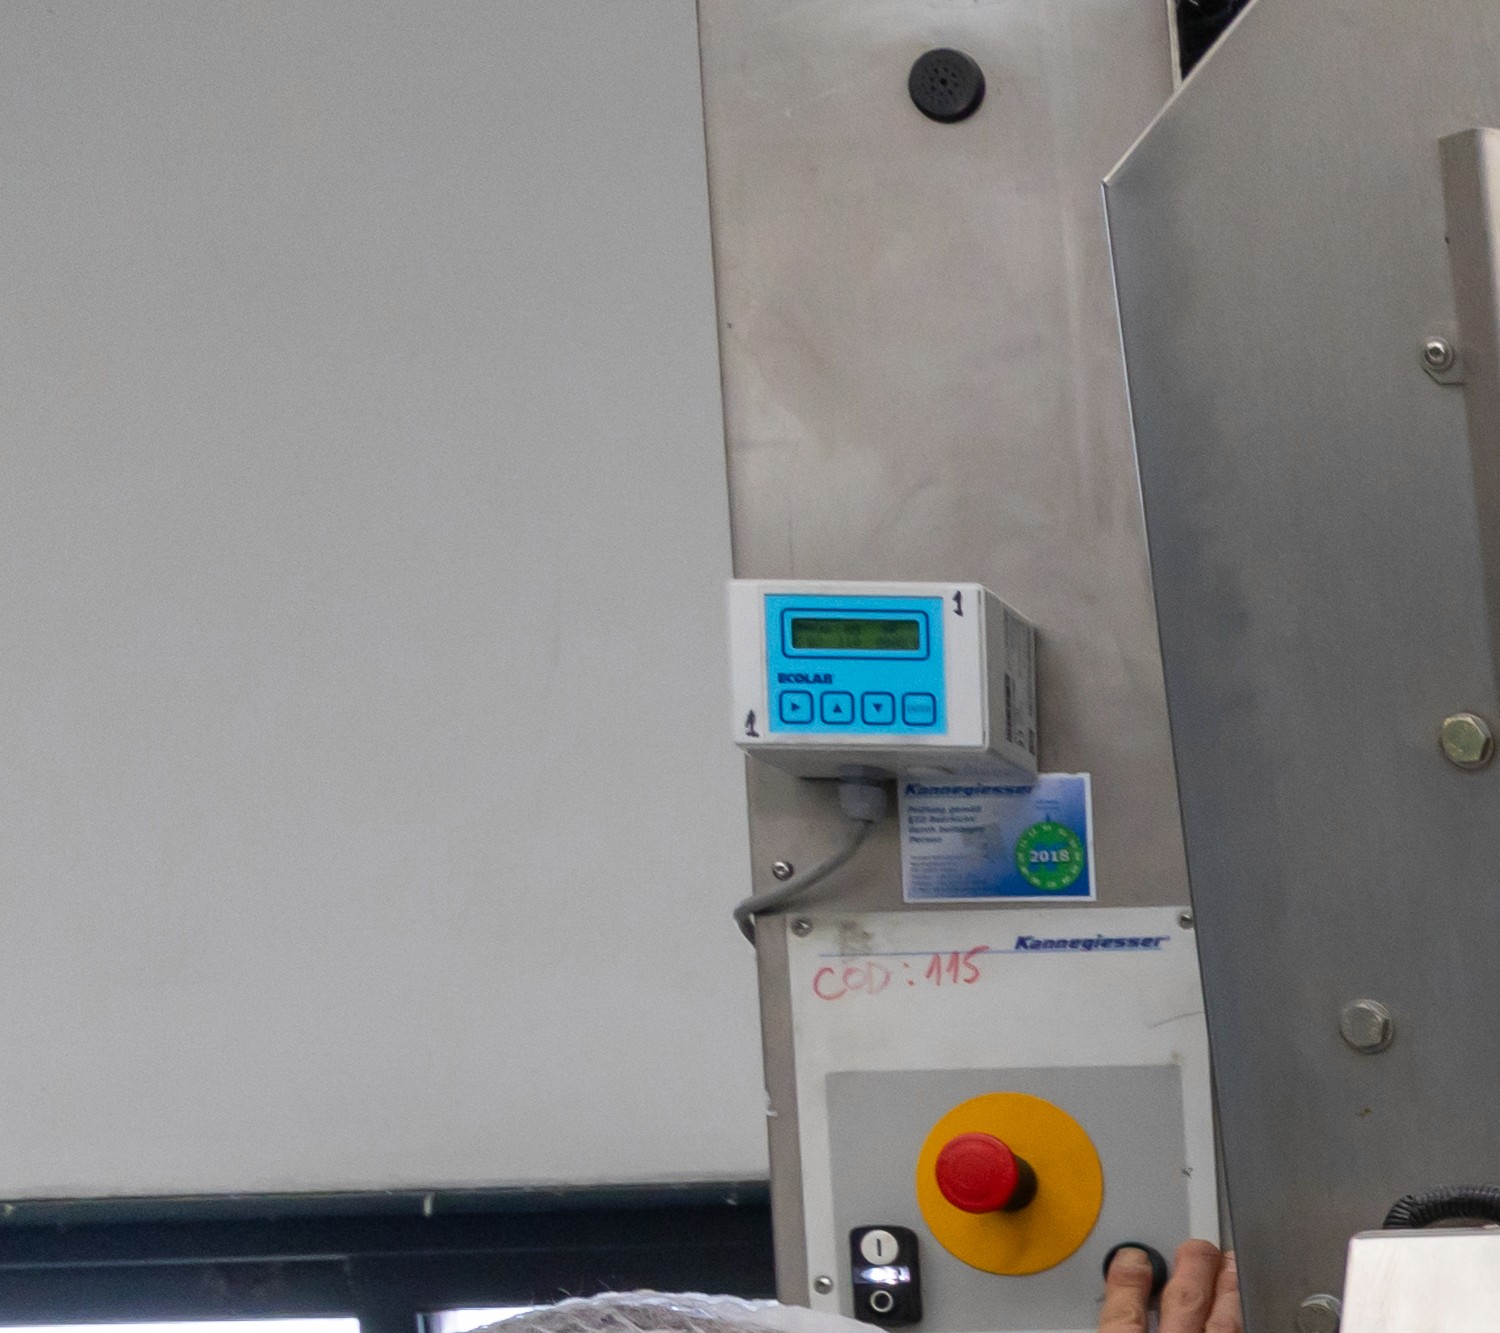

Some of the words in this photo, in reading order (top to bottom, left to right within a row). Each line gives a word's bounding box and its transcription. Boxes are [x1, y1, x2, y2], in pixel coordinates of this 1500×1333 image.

[952, 590, 964, 617] 1
[777, 671, 833, 685] ECOLAB
[1029, 849, 1070, 863] 2018
[1014, 934, 1169, 952] Kannegiesser
